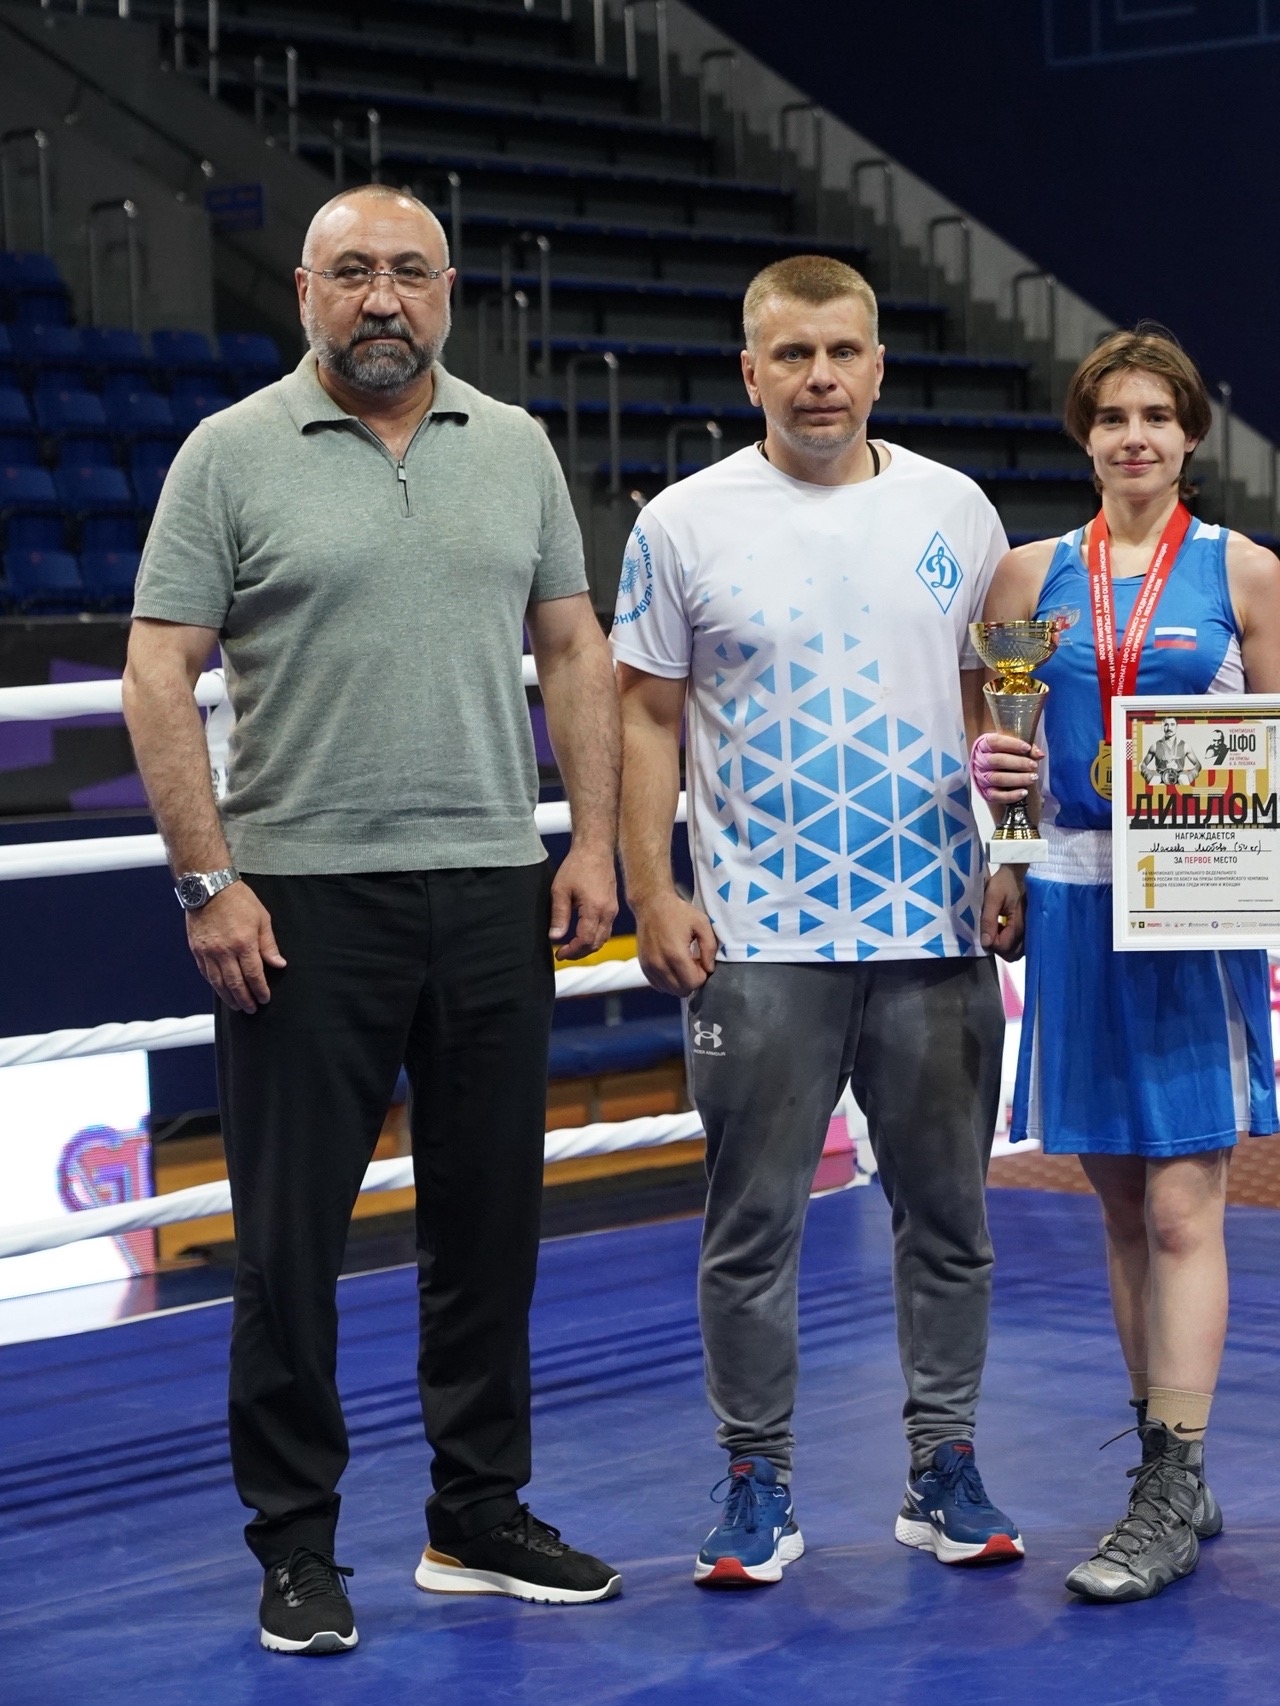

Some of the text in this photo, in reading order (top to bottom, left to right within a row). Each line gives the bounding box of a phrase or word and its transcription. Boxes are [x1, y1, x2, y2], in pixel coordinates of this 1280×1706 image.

[614, 535, 653, 625] БОКСА ЧЕЛЯБИНС
[1229, 734, 1256, 752] ЦФО
[1130, 792, 1279, 828] ДИПЛОМ
[1175, 832, 1235, 840] НАГРАЖДАЕТСЯ
[1174, 856, 1238, 864] ЗА ПЕРВОЕ МЕСТО
[1137, 855, 1155, 909] 1
